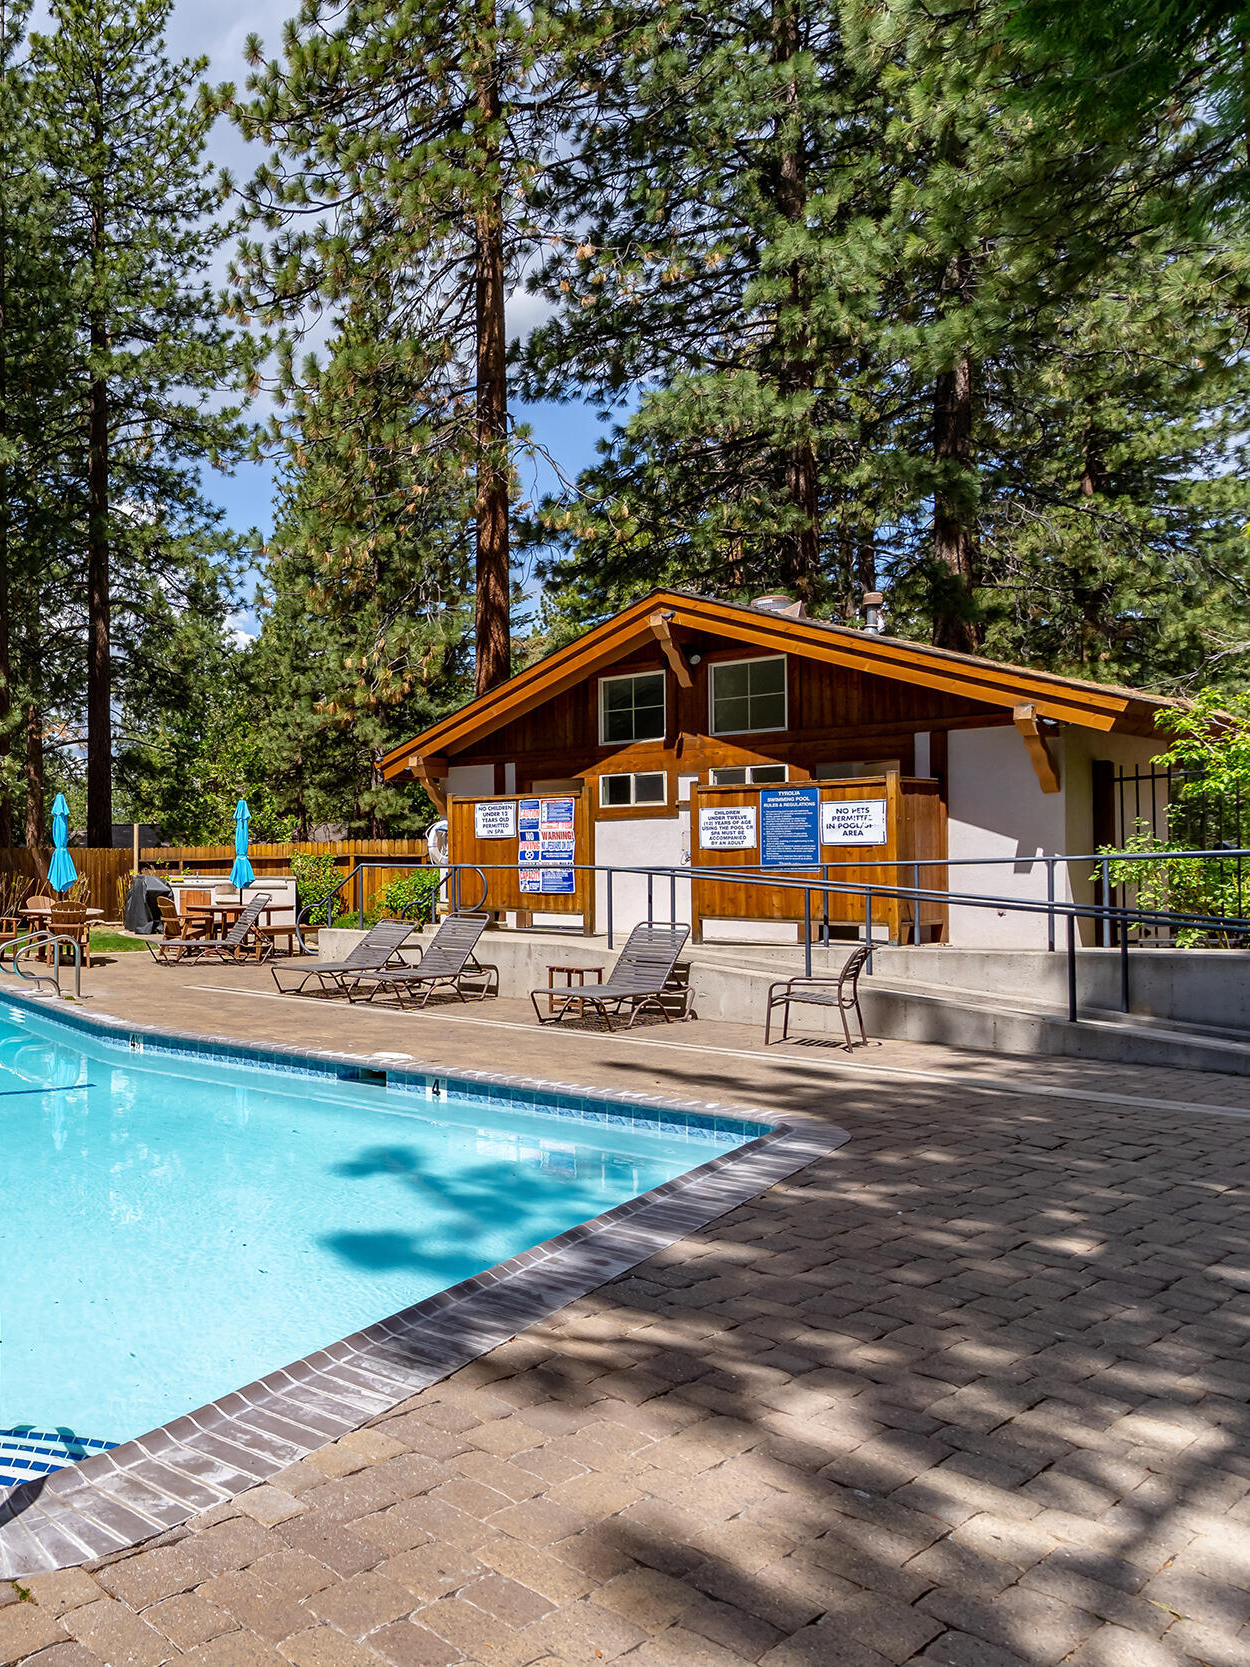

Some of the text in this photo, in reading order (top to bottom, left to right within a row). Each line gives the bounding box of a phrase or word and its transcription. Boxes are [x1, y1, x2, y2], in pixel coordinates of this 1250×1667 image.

[526, 832, 534, 841] NO
[542, 831, 574, 840] WARNING!
[520, 841, 540, 850] DIVING
[520, 872, 540, 880] CAPACITY
[432, 1079, 440, 1096] 4
